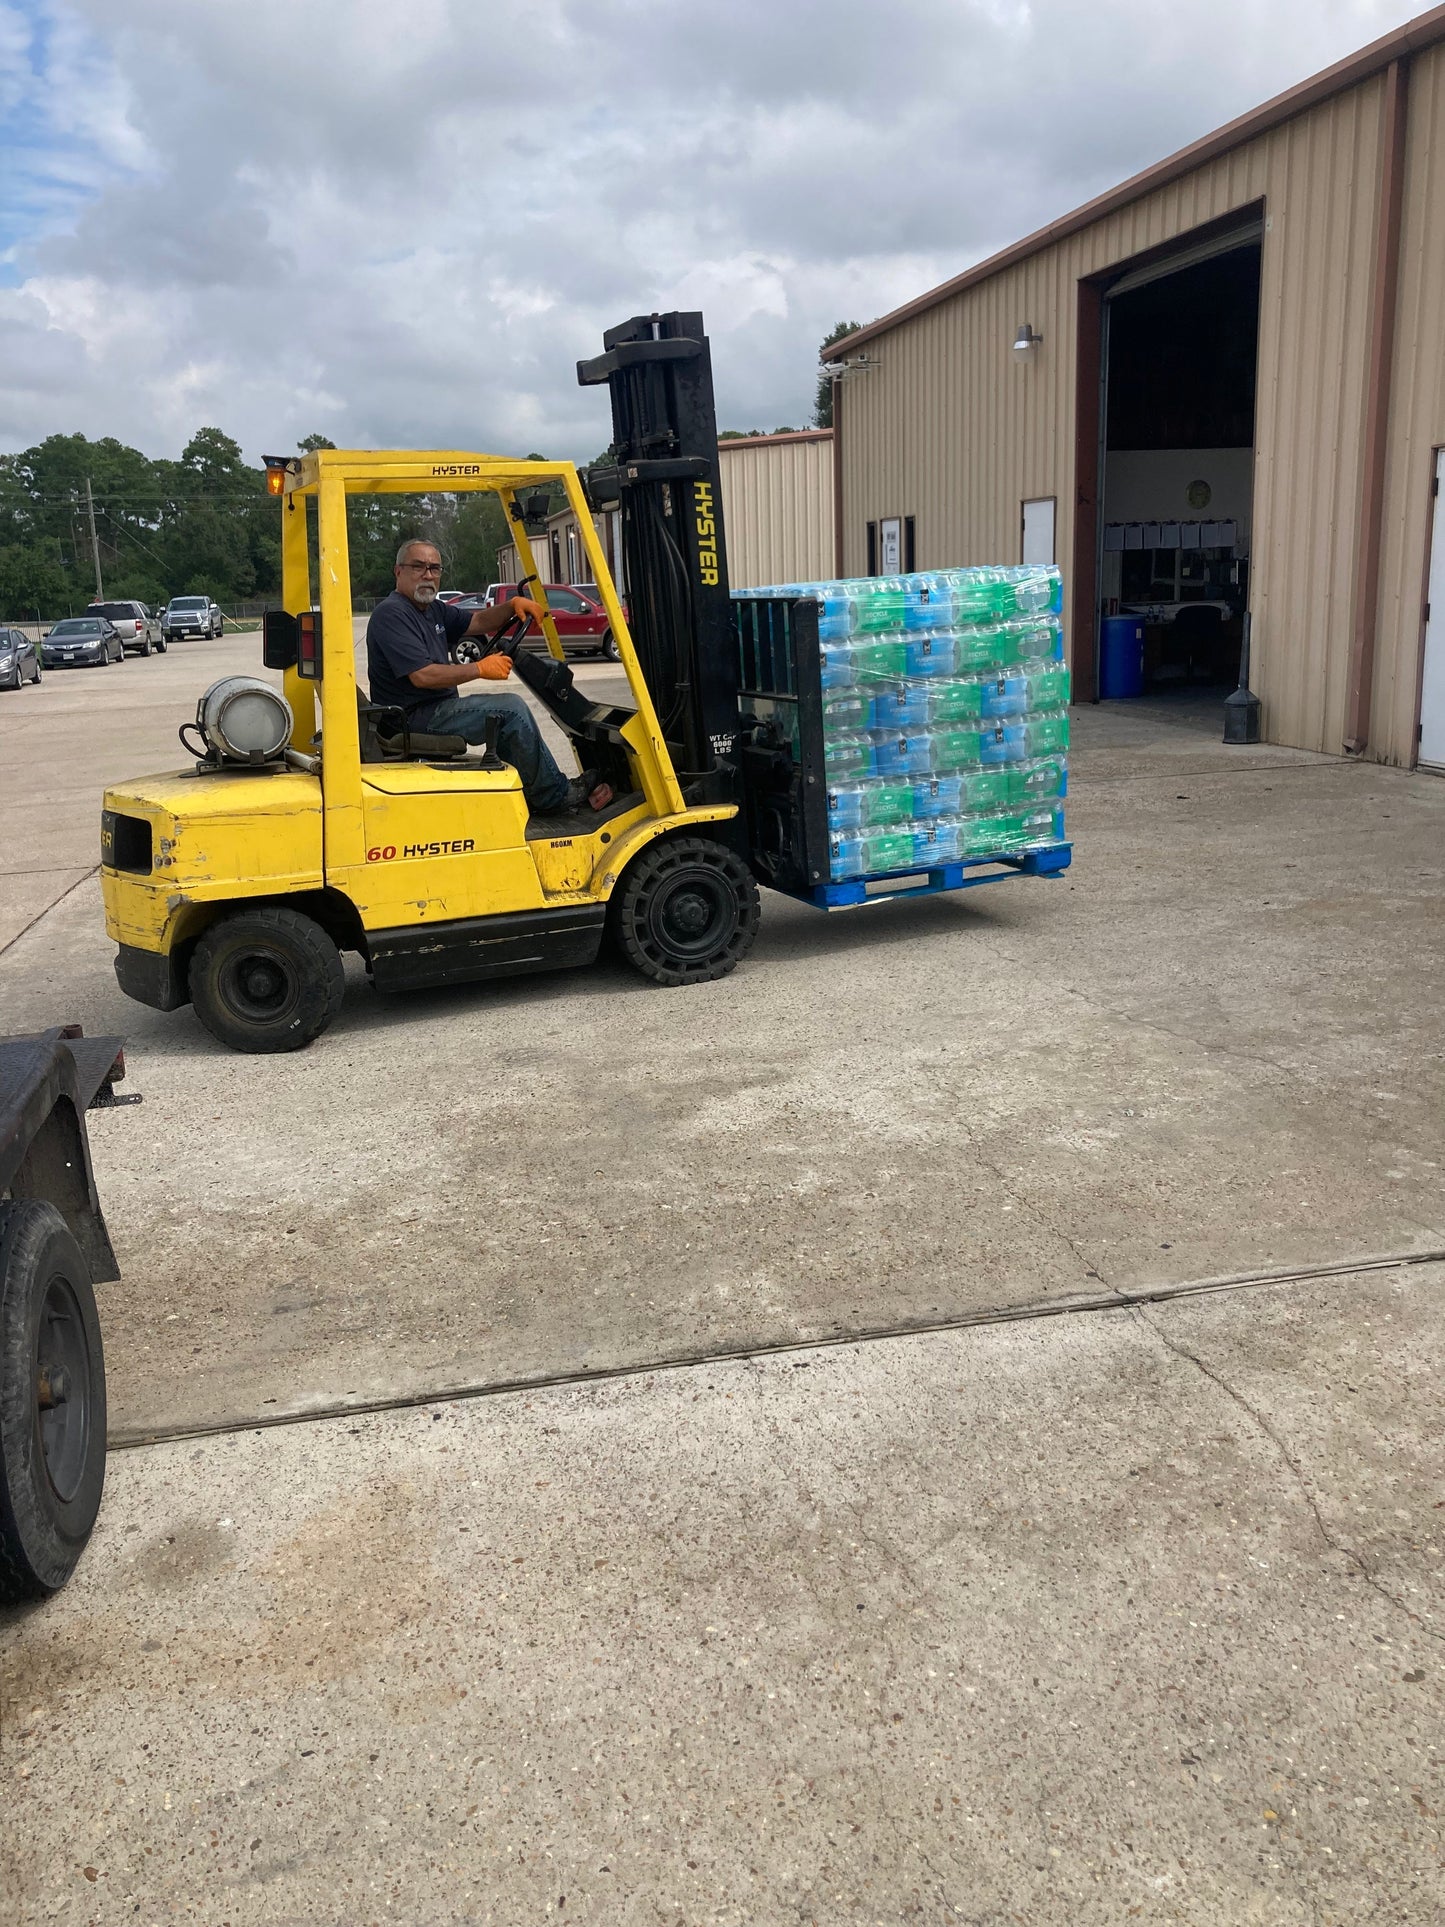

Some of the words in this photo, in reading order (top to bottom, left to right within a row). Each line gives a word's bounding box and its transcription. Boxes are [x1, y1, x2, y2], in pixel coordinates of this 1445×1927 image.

[432, 466, 480, 475] HYSTER
[694, 482, 719, 586] HYSTER
[713, 740, 732, 748] 6000
[714, 746, 732, 754] LBS
[367, 846, 397, 861] 60
[403, 839, 475, 857] HYSTER
